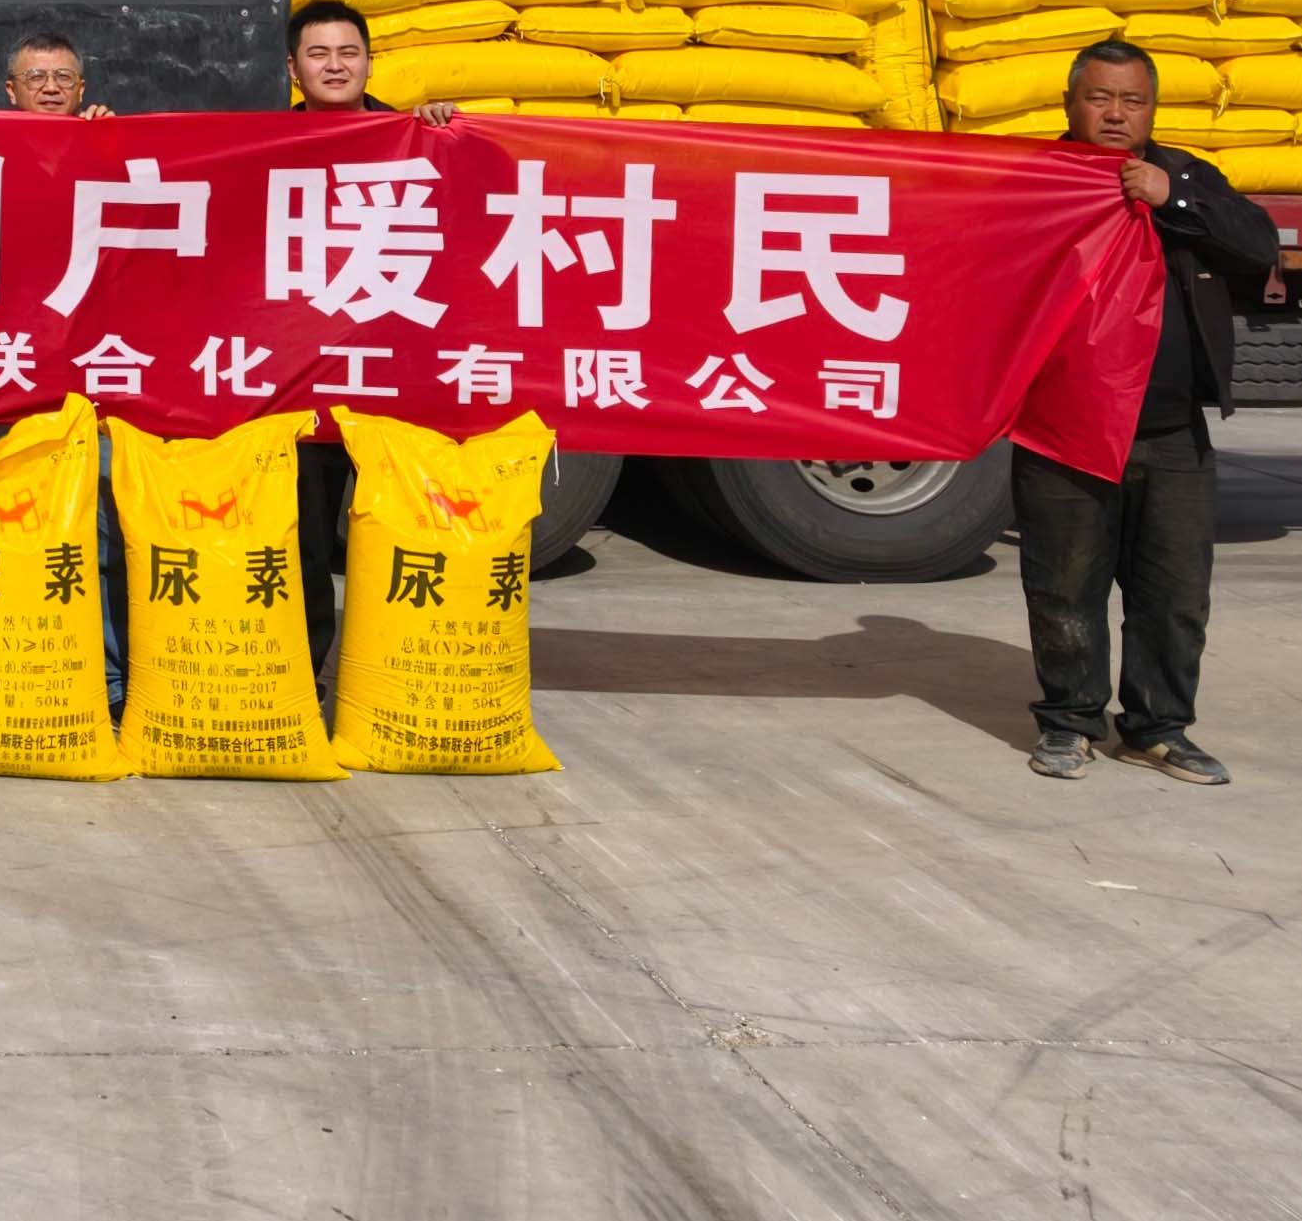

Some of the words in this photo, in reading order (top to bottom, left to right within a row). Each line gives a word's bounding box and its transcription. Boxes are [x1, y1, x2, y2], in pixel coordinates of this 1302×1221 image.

[149, 543, 289, 609] 尿素
[385, 545, 525, 611] 尿素
[189, 617, 266, 634] 天然气制造
[429, 619, 502, 636] 天然气制造
